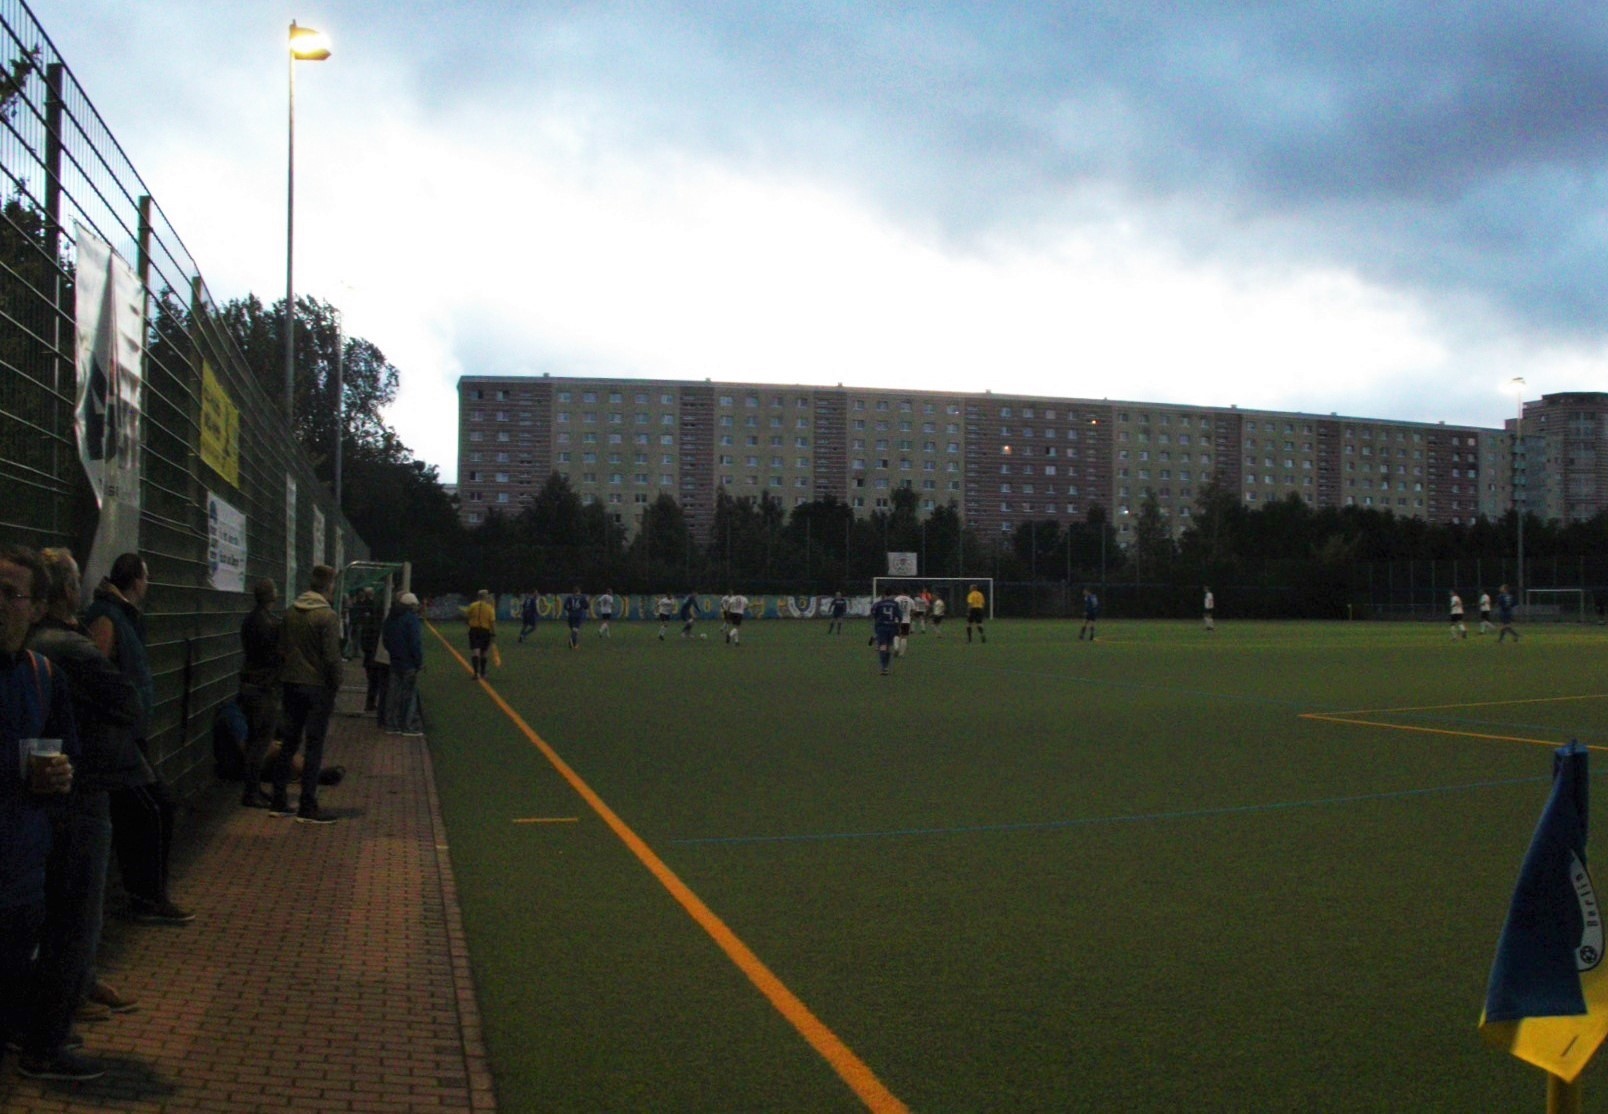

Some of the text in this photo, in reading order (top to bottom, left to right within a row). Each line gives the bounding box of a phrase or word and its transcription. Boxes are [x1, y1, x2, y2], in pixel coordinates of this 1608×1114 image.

[572, 598, 581, 608] 16
[883, 607, 893, 620] 4
[1576, 873, 1599, 926] Berlin
